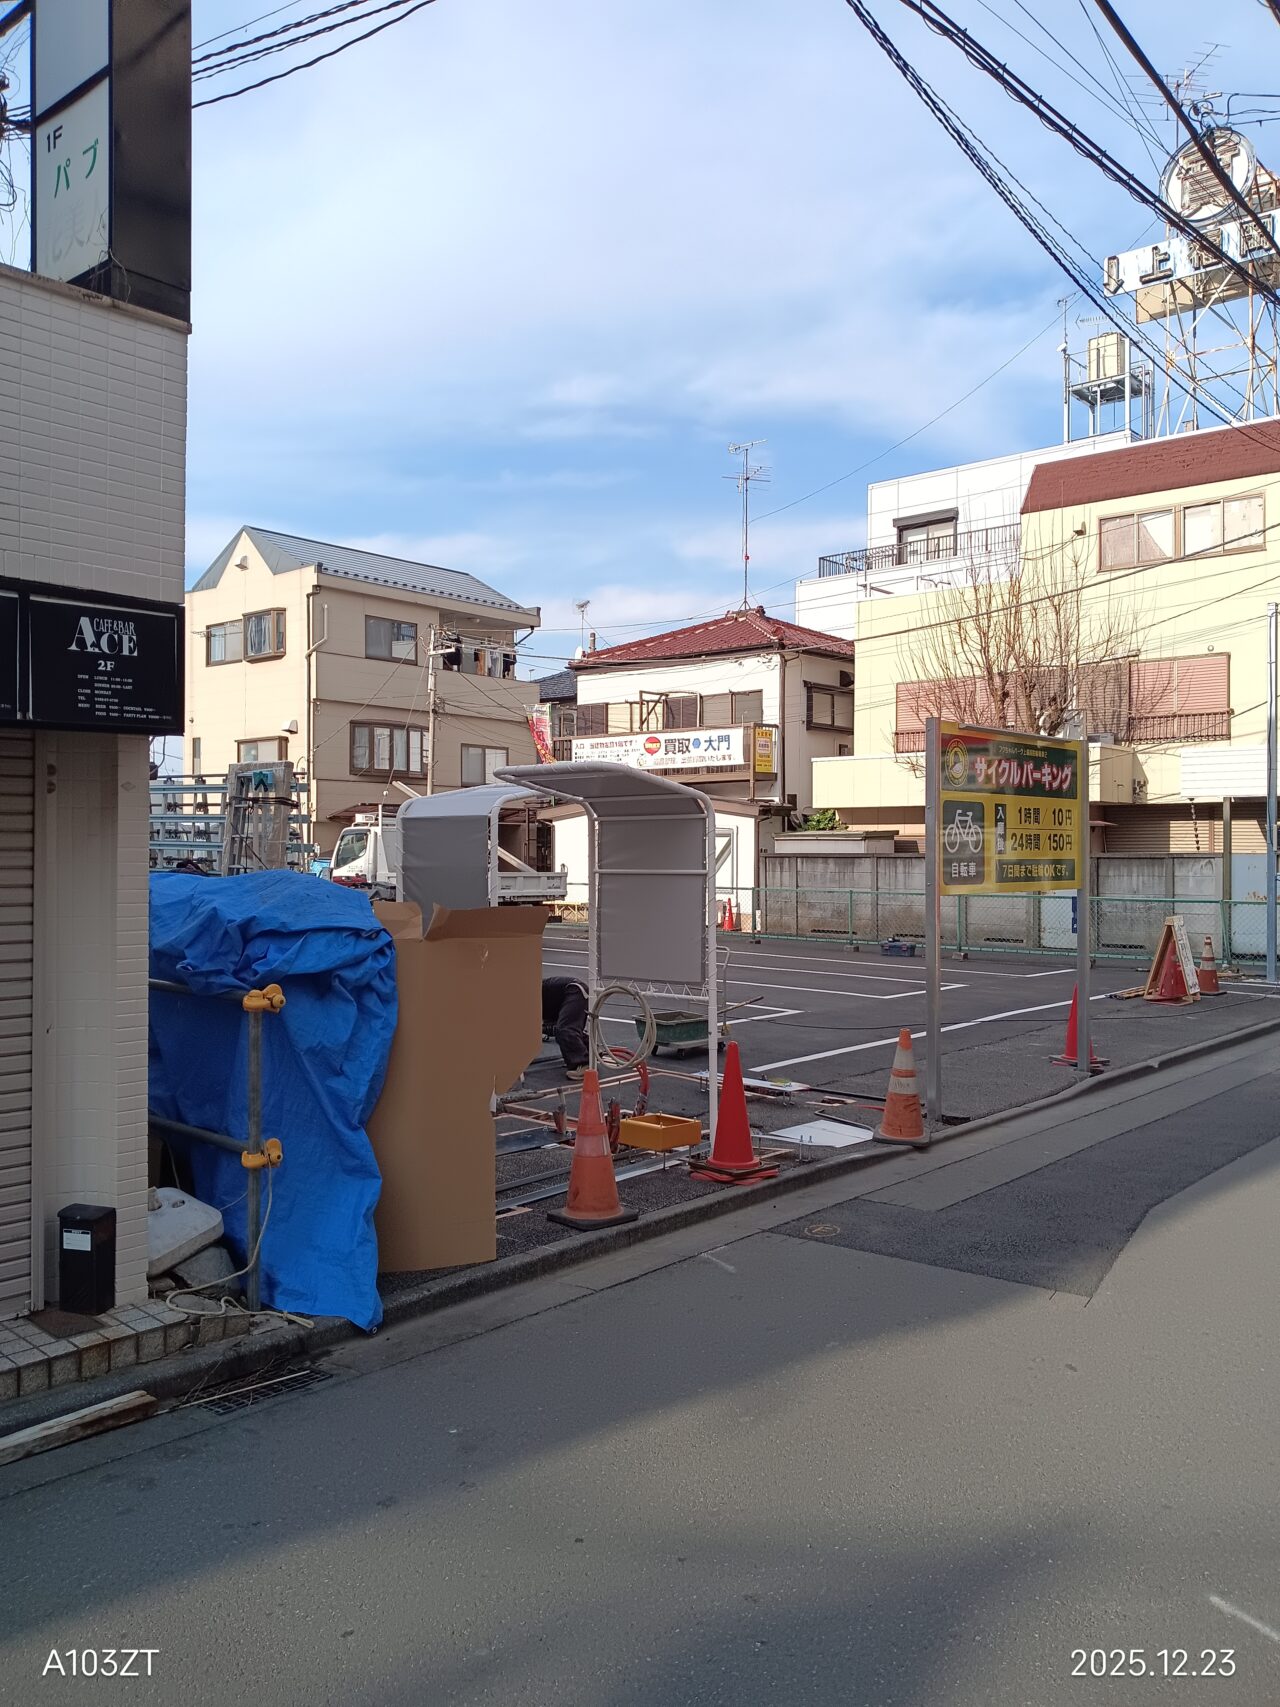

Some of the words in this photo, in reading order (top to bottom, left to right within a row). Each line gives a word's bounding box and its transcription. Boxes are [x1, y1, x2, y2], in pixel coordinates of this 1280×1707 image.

[46, 125, 64, 153] 1F
[67, 616, 138, 657] ACE
[97, 660, 115, 671] 2F
[664, 738, 691, 755] 買取
[704, 735, 730, 752] 大門
[974, 756, 1073, 793] サイクルパーキング
[951, 862, 977, 878] 自転車
